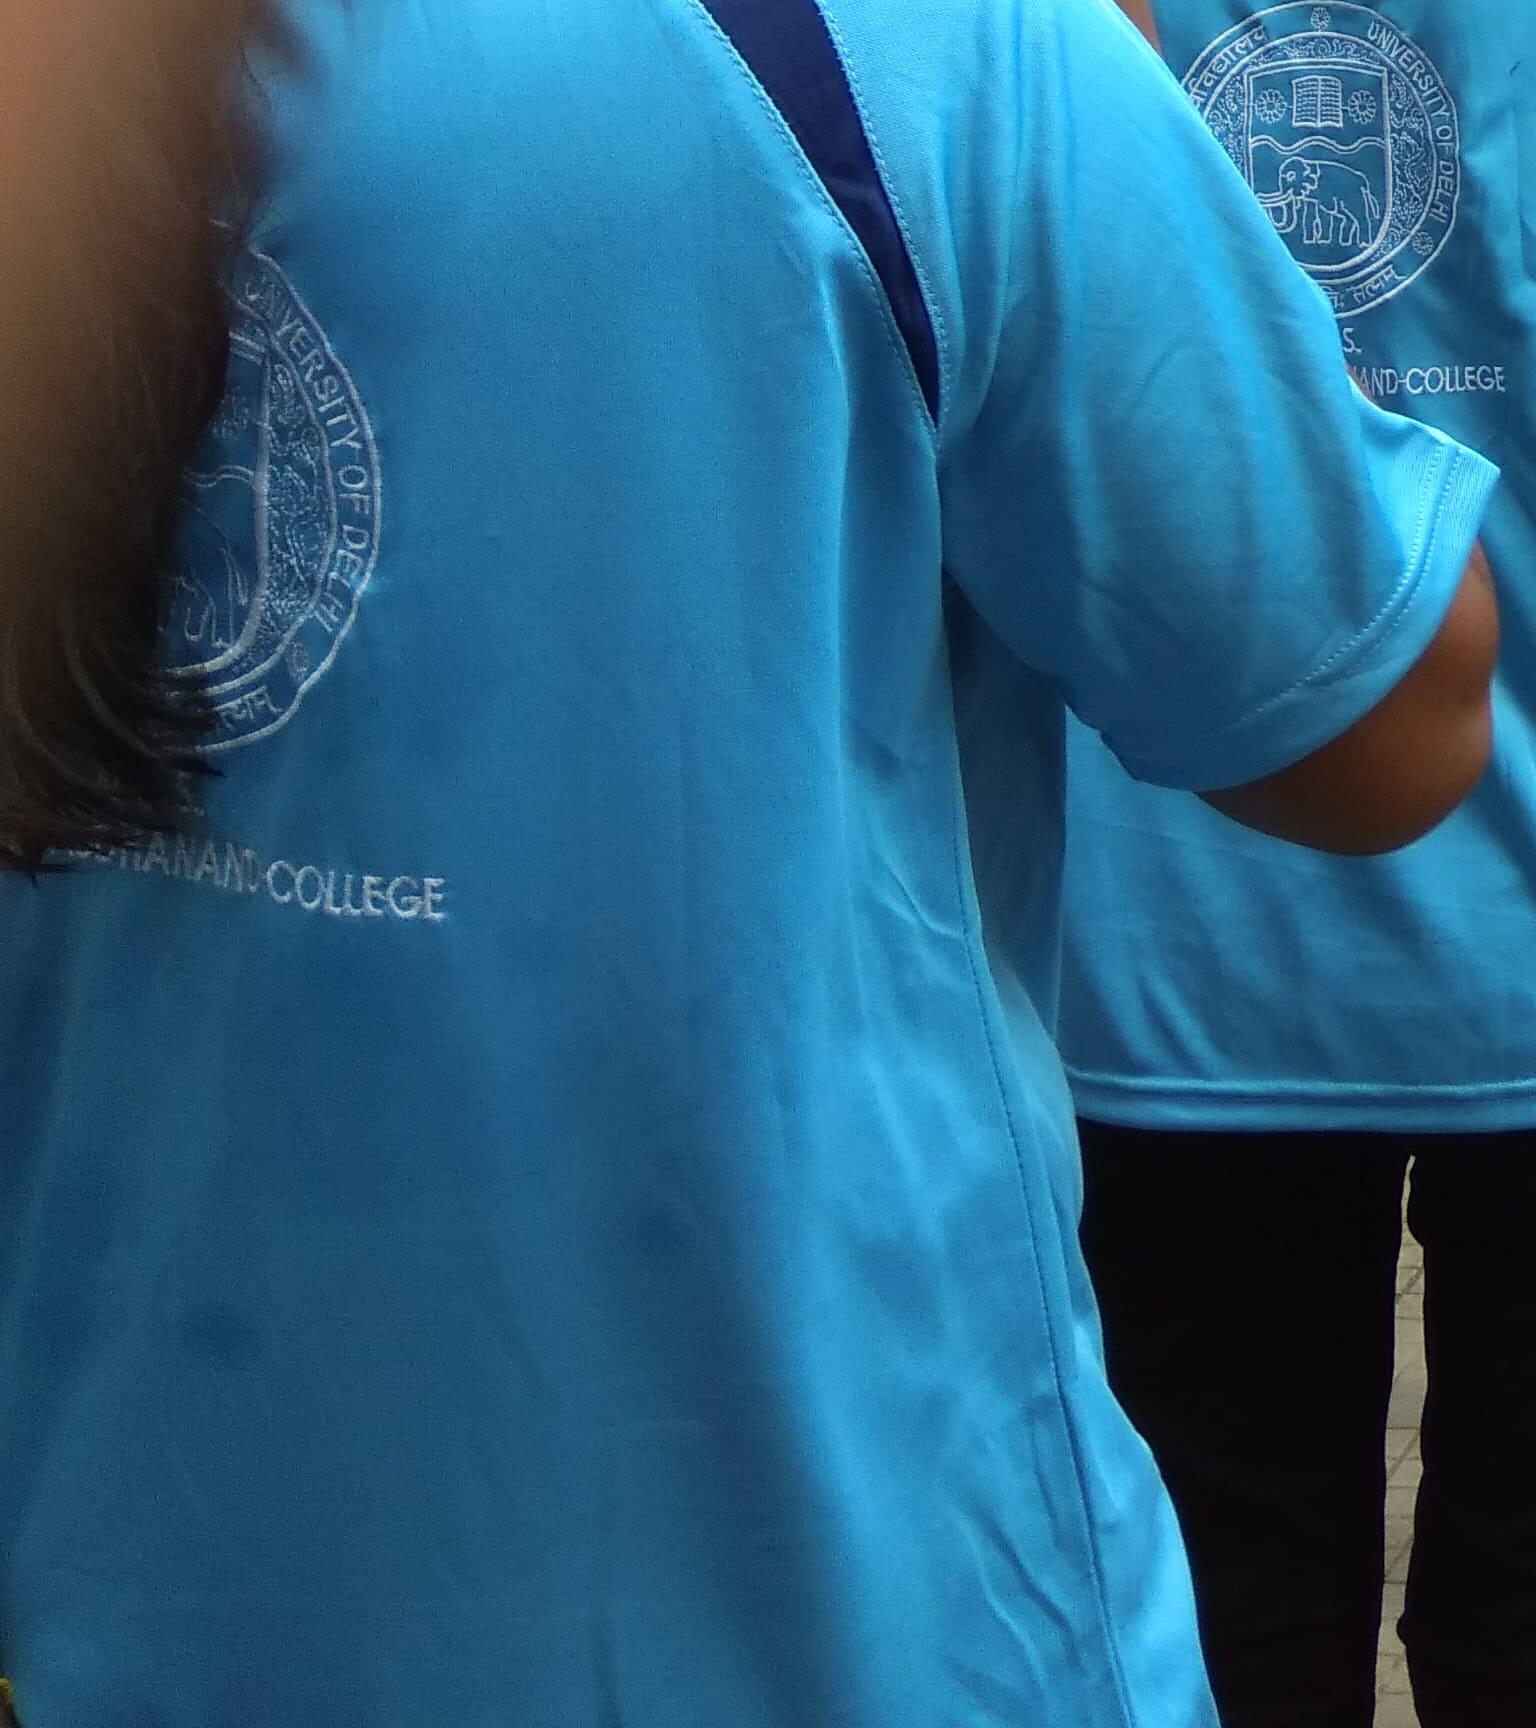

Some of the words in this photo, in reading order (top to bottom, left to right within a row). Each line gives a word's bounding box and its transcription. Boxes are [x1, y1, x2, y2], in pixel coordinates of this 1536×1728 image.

[1366, 21, 1451, 119] UNIVERSITY
[1435, 123, 1454, 154] OF
[1429, 158, 1456, 223] DELHI
